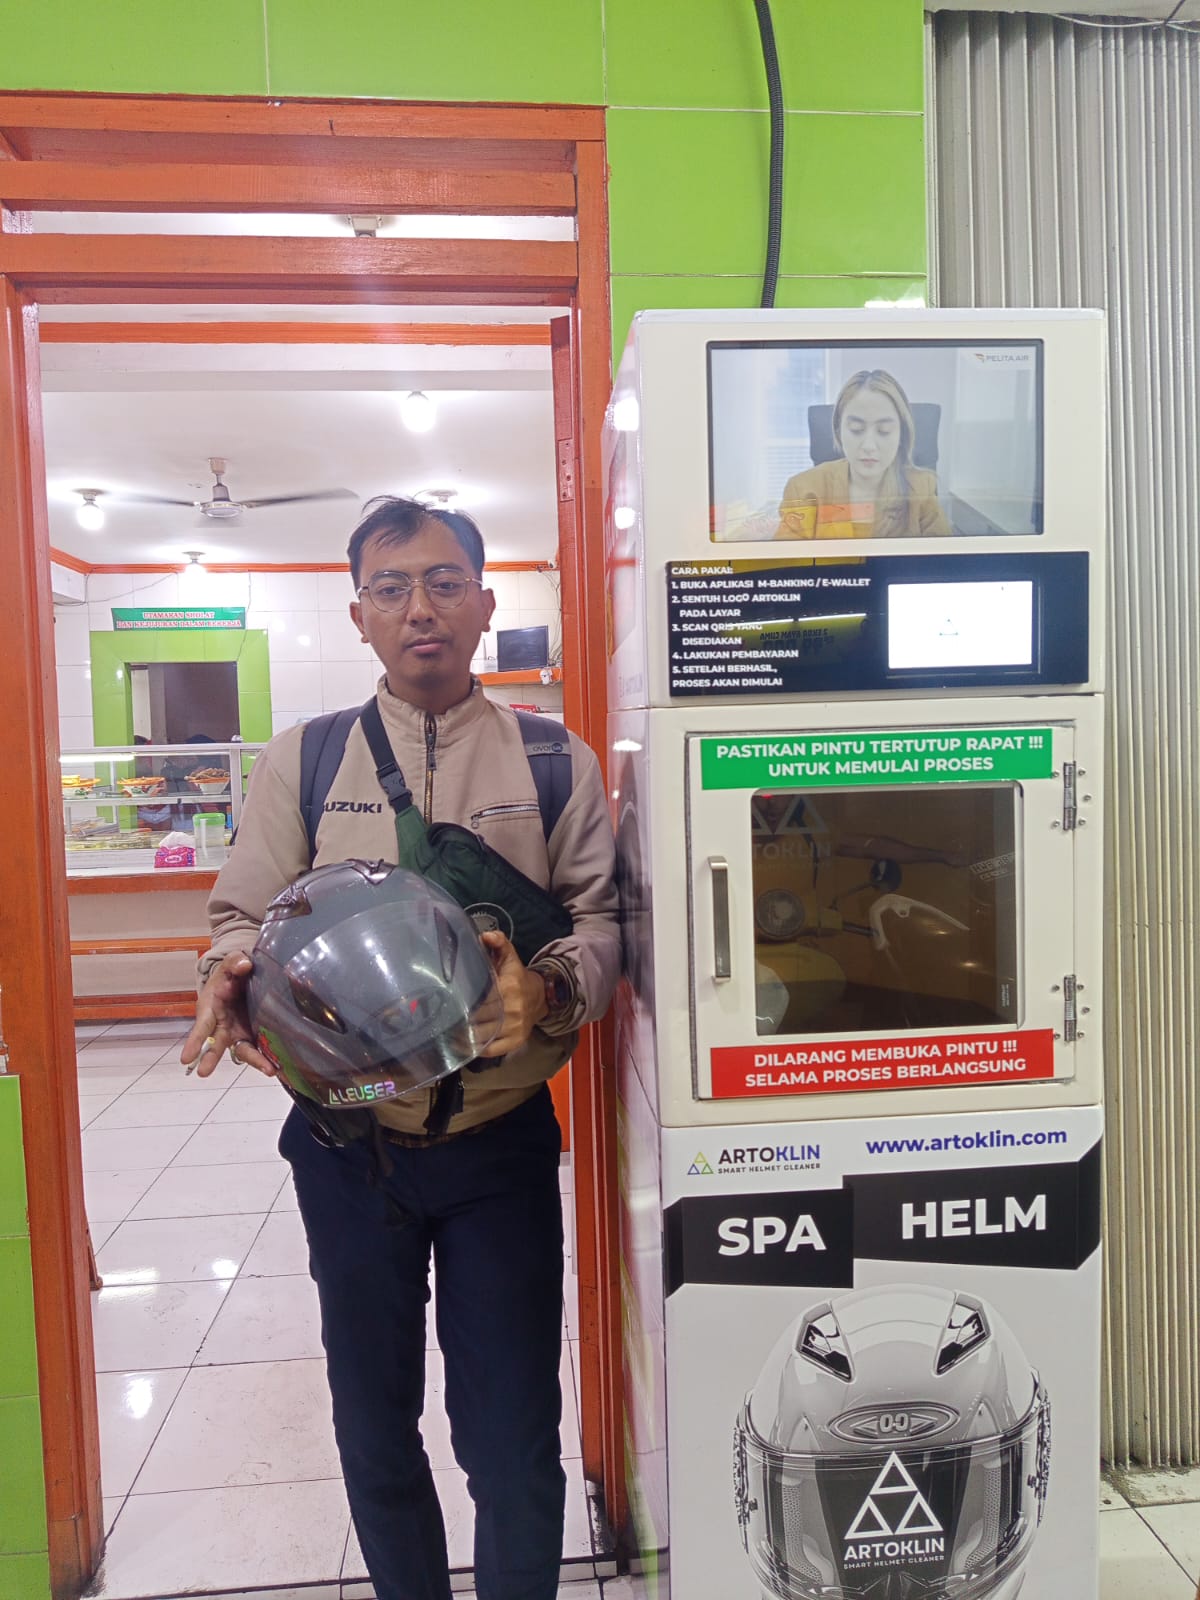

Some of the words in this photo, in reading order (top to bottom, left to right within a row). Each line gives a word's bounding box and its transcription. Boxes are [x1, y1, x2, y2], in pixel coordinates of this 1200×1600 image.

[671, 567, 698, 575] CARA
[680, 581, 708, 589] BUKA
[709, 580, 753, 589] APLIKASI
[758, 579, 814, 588] M-BANKING
[815, 578, 821, 587] /
[822, 578, 871, 587] E-WALLET
[672, 595, 680, 603] 2.
[682, 595, 721, 603] SENTUH
[723, 593, 749, 602] LOGO
[752, 594, 801, 602] ARTOKLIN
[680, 609, 708, 617] PADA
[709, 609, 741, 617] LAYAR
[672, 624, 680, 632] 3.
[682, 623, 709, 631] SCAN
[711, 623, 734, 633] QRIS
[682, 637, 742, 646] DISEDIAKAN
[672, 652, 682, 660] 4.
[684, 651, 730, 660] LAKUKAN
[731, 650, 799, 659] PEMBAYARAN
[672, 666, 680, 674] 5.
[682, 665, 725, 673] SETELAH
[727, 664, 778, 673] BERHASIL,
[673, 679, 710, 688] PROSES
[712, 679, 740, 687] AKAN
[742, 678, 782, 686] DIMULAI
[716, 743, 806, 759] PASTIKAN
[811, 741, 865, 756] PINTU
[869, 738, 961, 754] TERTUTUP
[966, 736, 1024, 751] RAPAT
[1028, 735, 1044, 749] !!!
[768, 762, 830, 777] UNTUK
[835, 759, 919, 775] MEMULAI
[924, 756, 994, 773] PROSES
[323, 801, 382, 813] UZUKI
[751, 841, 831, 859] TOKLIN
[754, 1049, 846, 1068] DILARANG
[851, 1044, 942, 1063] MEMBUKA
[946, 1040, 999, 1056] PINTU
[1002, 1039, 1018, 1053] !!!
[745, 1071, 819, 1088] SELAMA
[823, 1067, 892, 1083] PROSES
[897, 1058, 1027, 1079] BERLANGSUNG
[866, 1129, 1068, 1154] www.artoklin.com
[718, 1144, 821, 1165] ARTOKLIN
[718, 1166, 746, 1175] SMART
[749, 1164, 781, 1173] HELMET
[783, 1162, 821, 1171] CLEANER
[717, 1214, 827, 1257] SPA
[901, 1194, 1047, 1240] HELM
[844, 1537, 945, 1561] ARTOKLIN
[844, 1561, 871, 1570] SMART
[874, 1558, 905, 1567] HELMET
[908, 1555, 945, 1564] CLEANER
